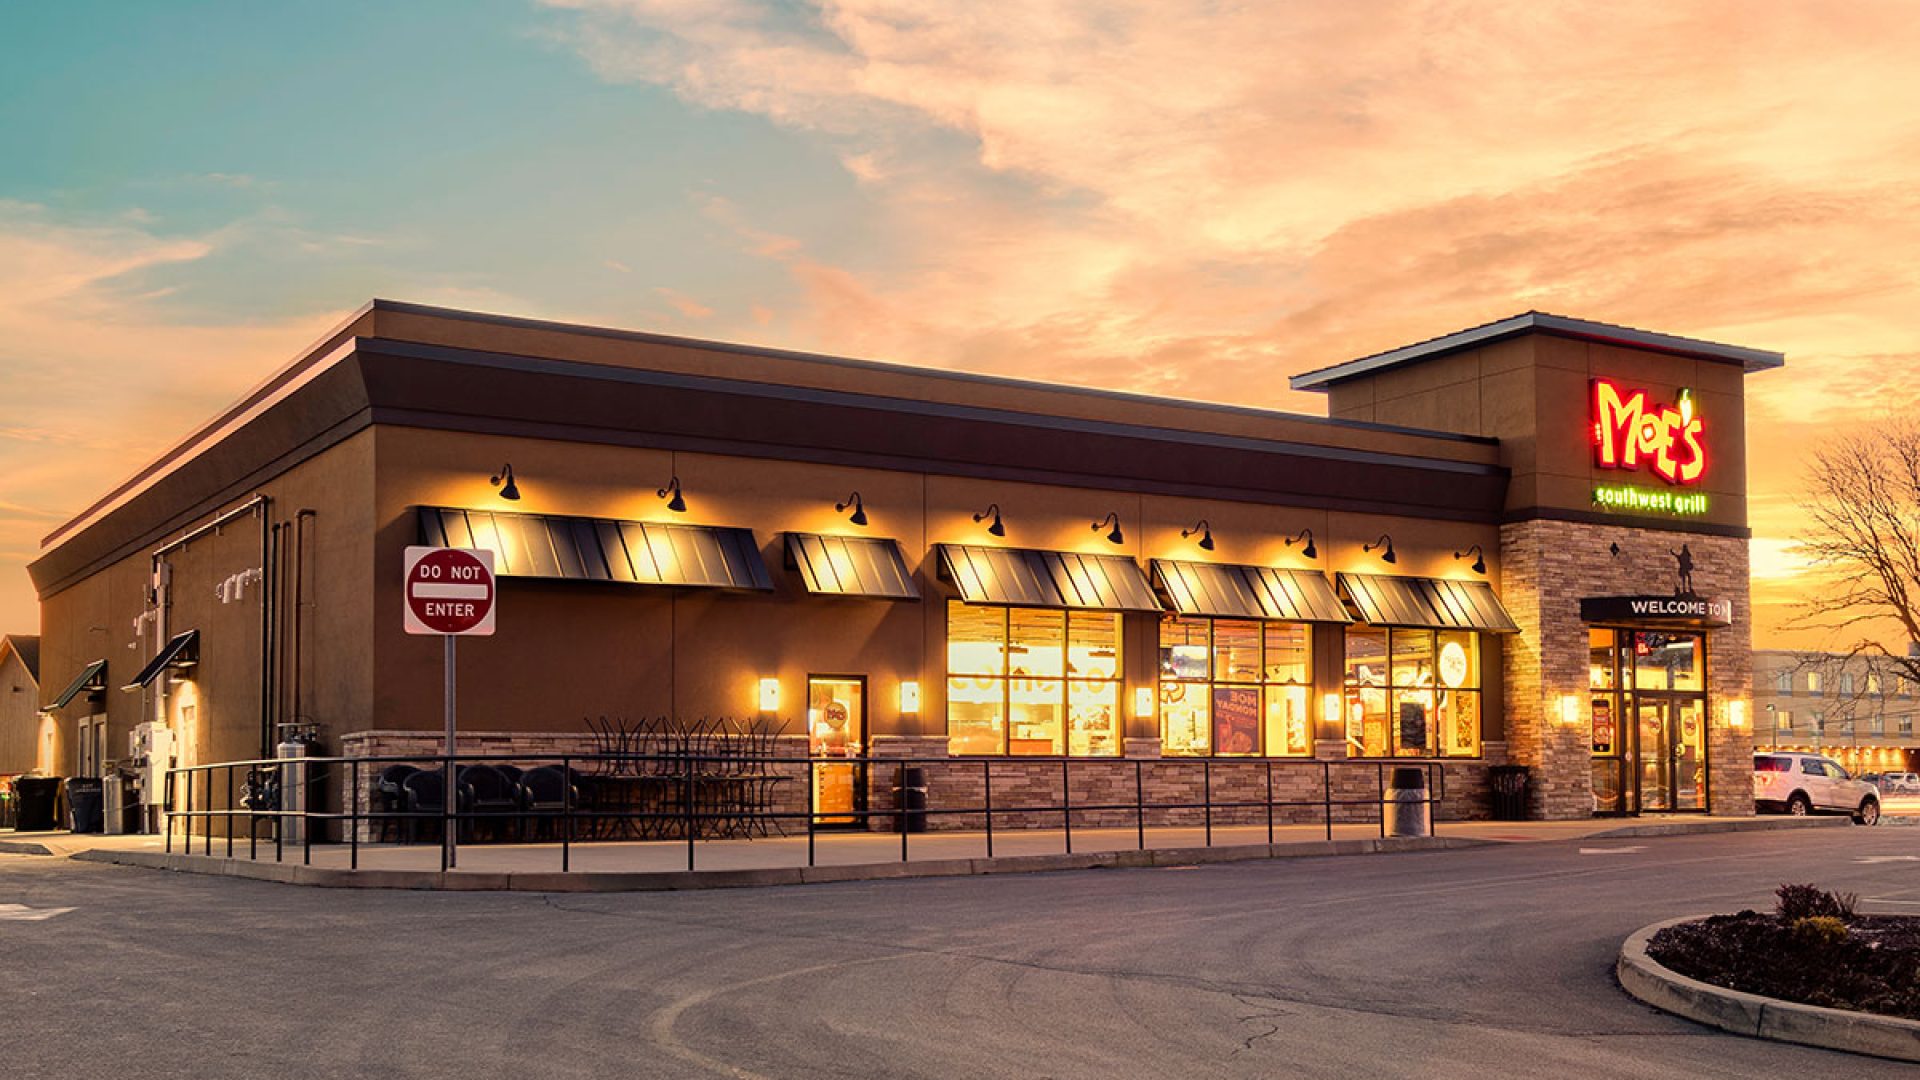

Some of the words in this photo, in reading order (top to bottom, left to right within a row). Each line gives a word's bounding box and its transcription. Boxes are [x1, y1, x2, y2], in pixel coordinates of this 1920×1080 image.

[1597, 487, 1671, 509] southwest
[1674, 495, 1706, 513] grill
[420, 564, 441, 579] DO
[451, 565, 481, 580] NOT
[425, 602, 475, 617] ENTER
[1631, 600, 1706, 615] WELCOME
[1708, 602, 1721, 616] TO
